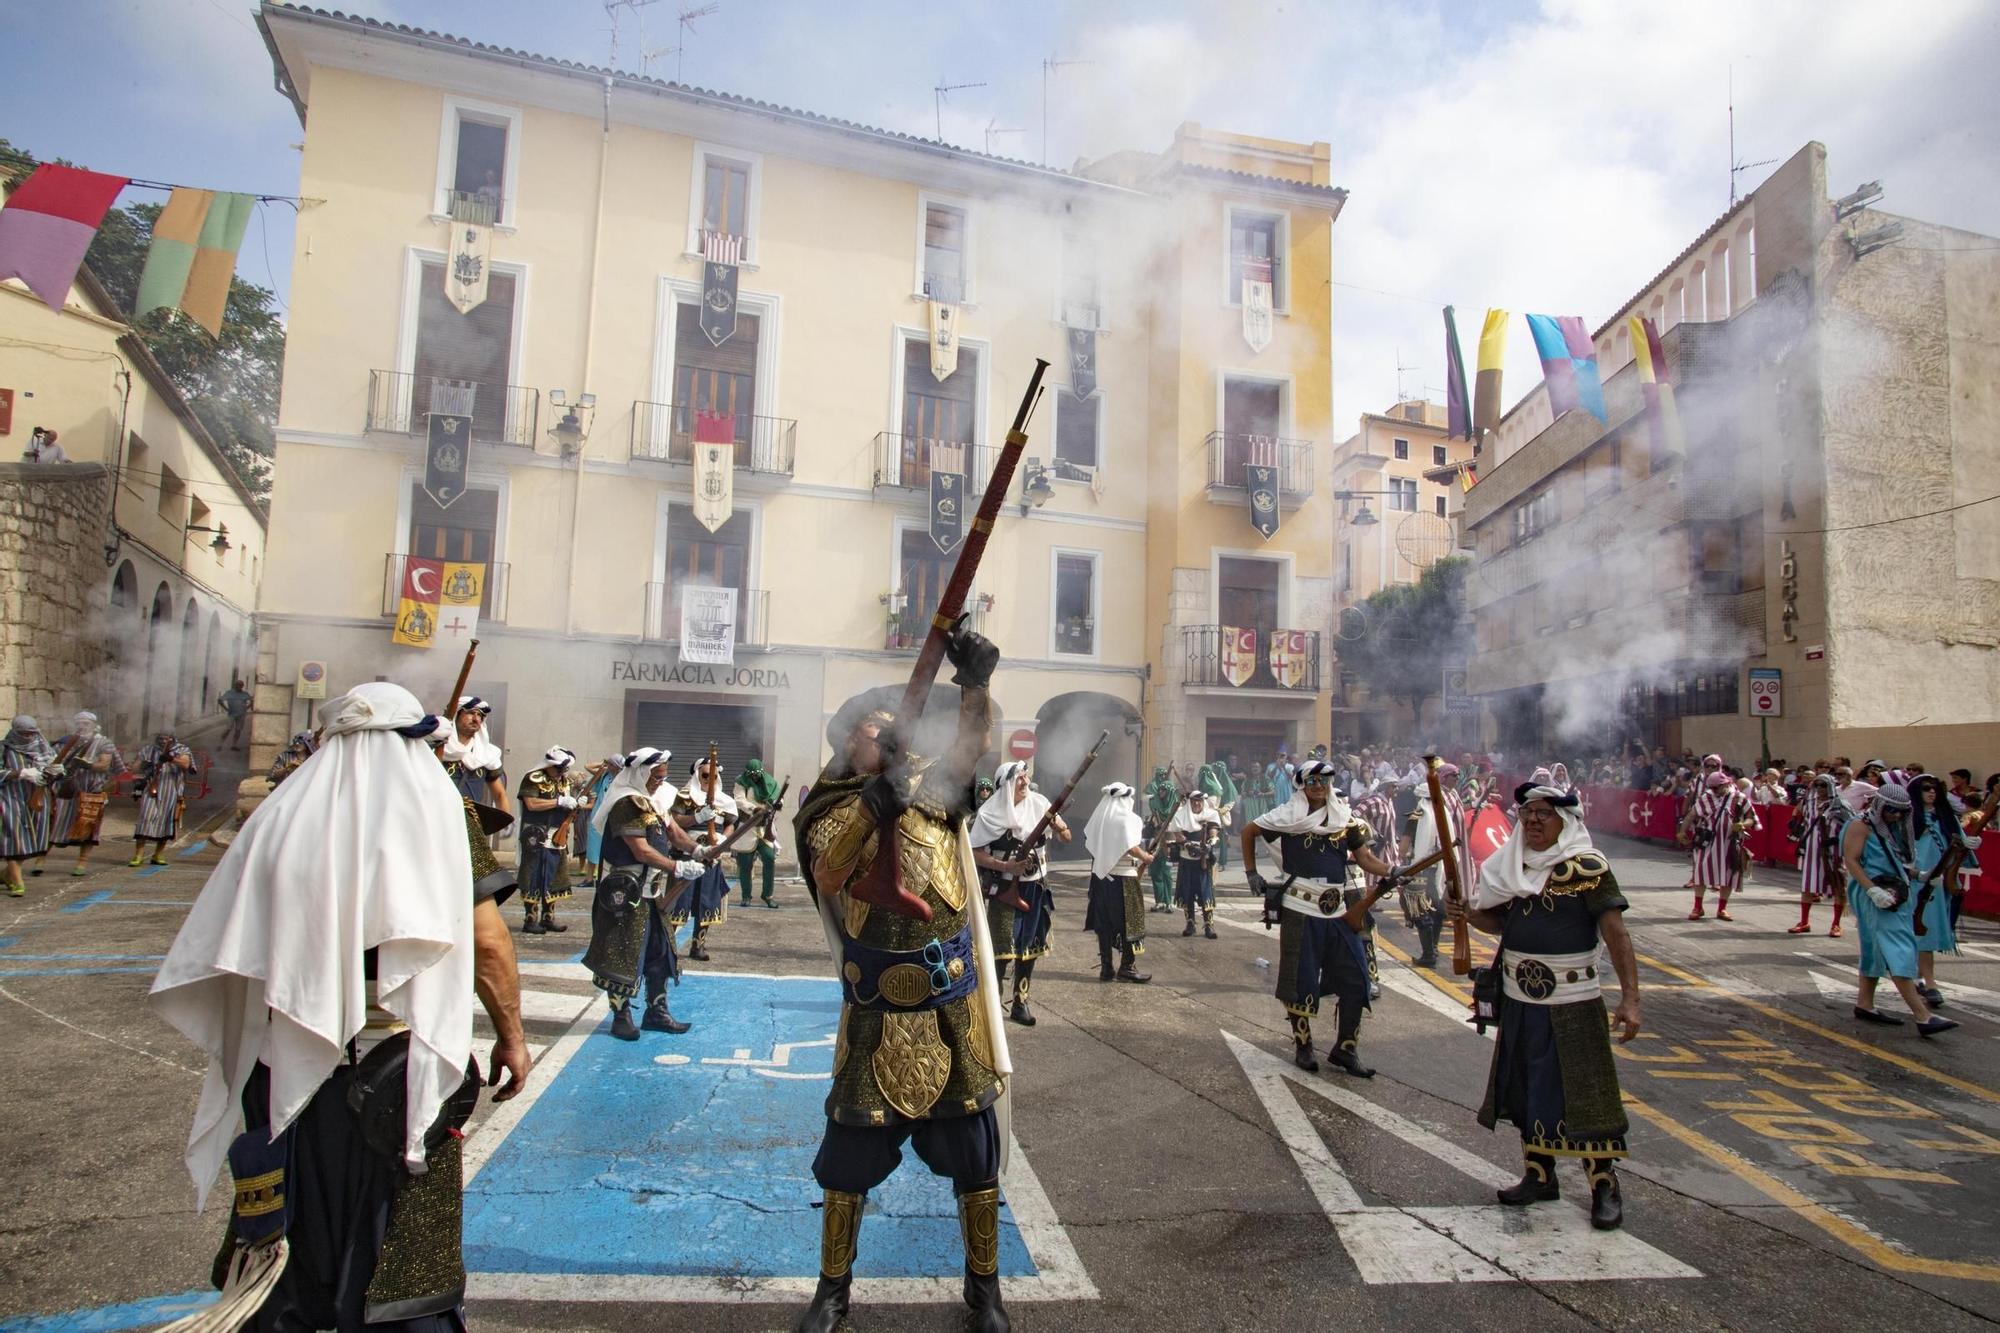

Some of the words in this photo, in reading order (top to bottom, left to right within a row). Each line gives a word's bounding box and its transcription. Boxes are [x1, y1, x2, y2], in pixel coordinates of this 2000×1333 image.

[1781, 539, 1799, 642] LOCAL
[612, 661, 716, 685] FARMACIA
[725, 667, 791, 689] JORDA
[1609, 1012, 1962, 1185] POLICI
